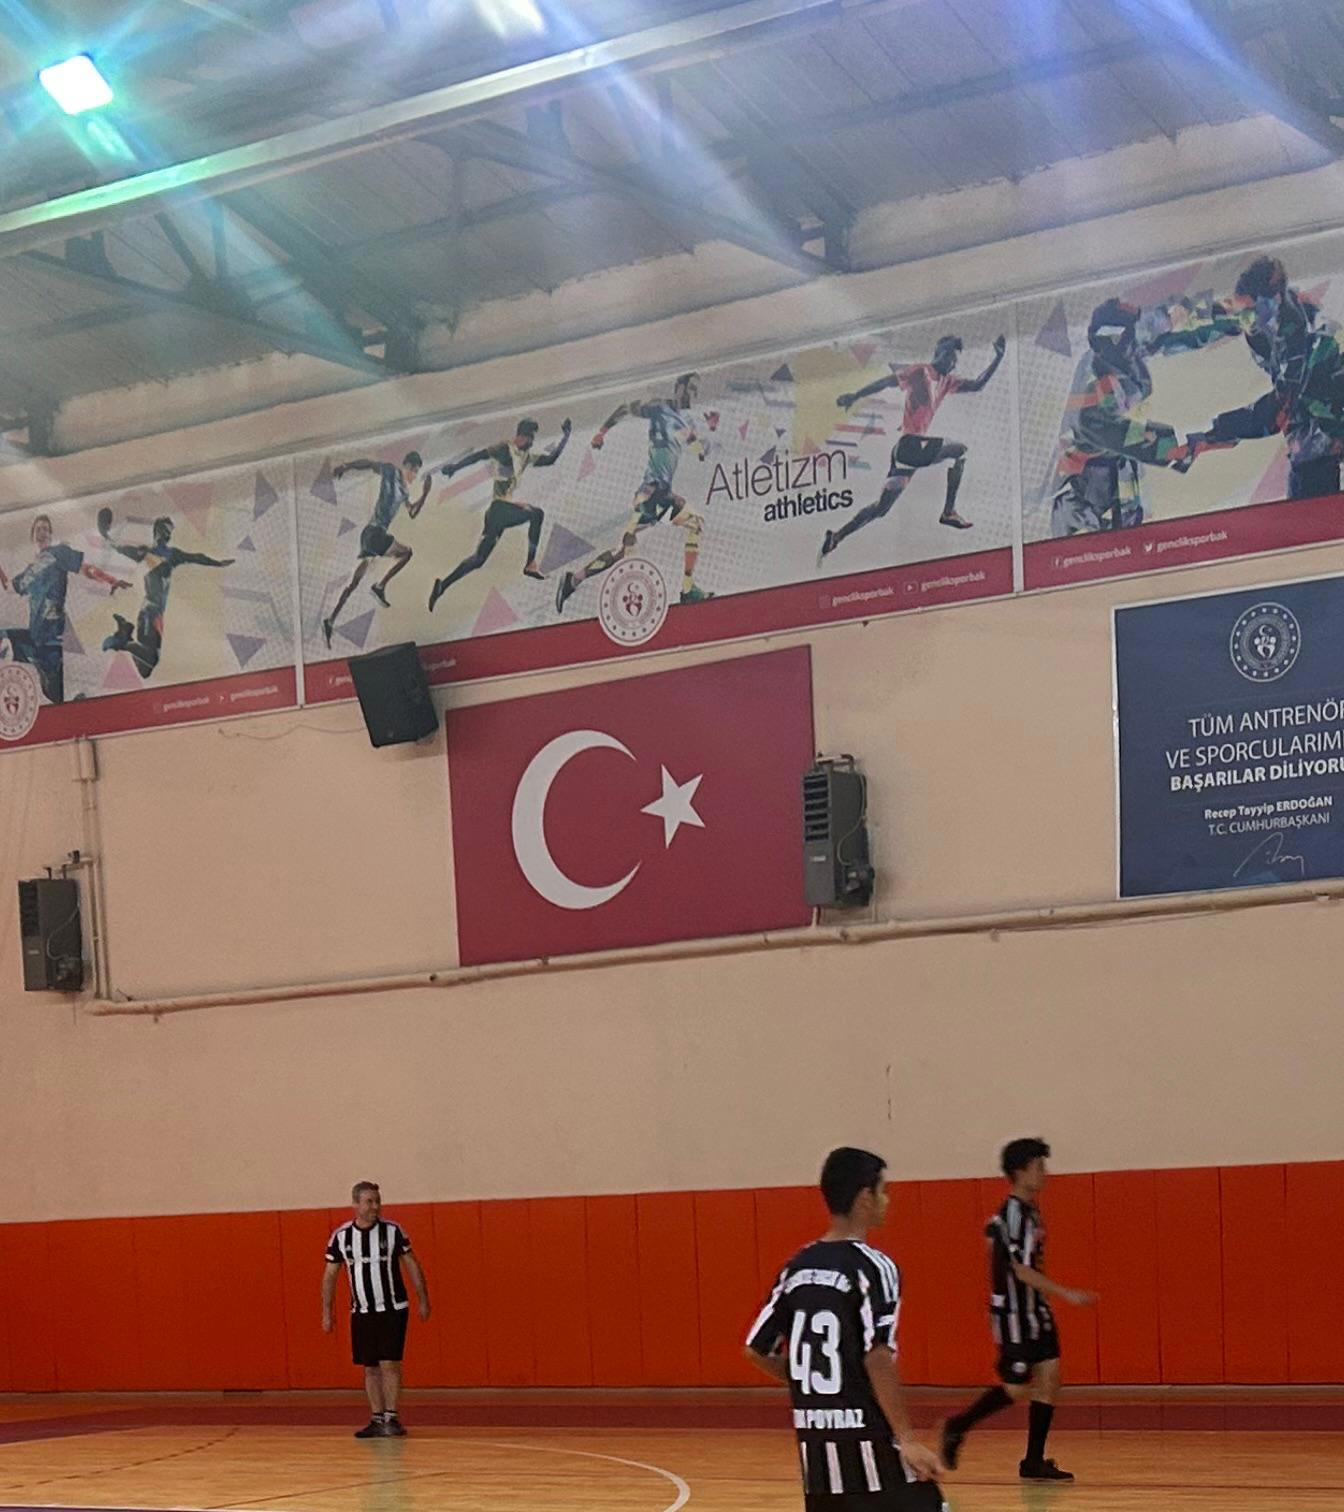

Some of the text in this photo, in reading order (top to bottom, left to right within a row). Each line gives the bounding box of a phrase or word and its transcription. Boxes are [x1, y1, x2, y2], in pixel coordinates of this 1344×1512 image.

[706, 448, 849, 506] Atletizm
[763, 484, 854, 525] athletics
[1189, 713, 1235, 738] TÜM
[1165, 748, 1191, 770] VE
[1170, 767, 1266, 793] BAŞARILAR
[1204, 795, 1333, 820] Recep Tayyip ERDOĞAN
[1208, 812, 1330, 836] T.C. CUMHURBAŞKANI
[789, 1310, 842, 1395] 43
